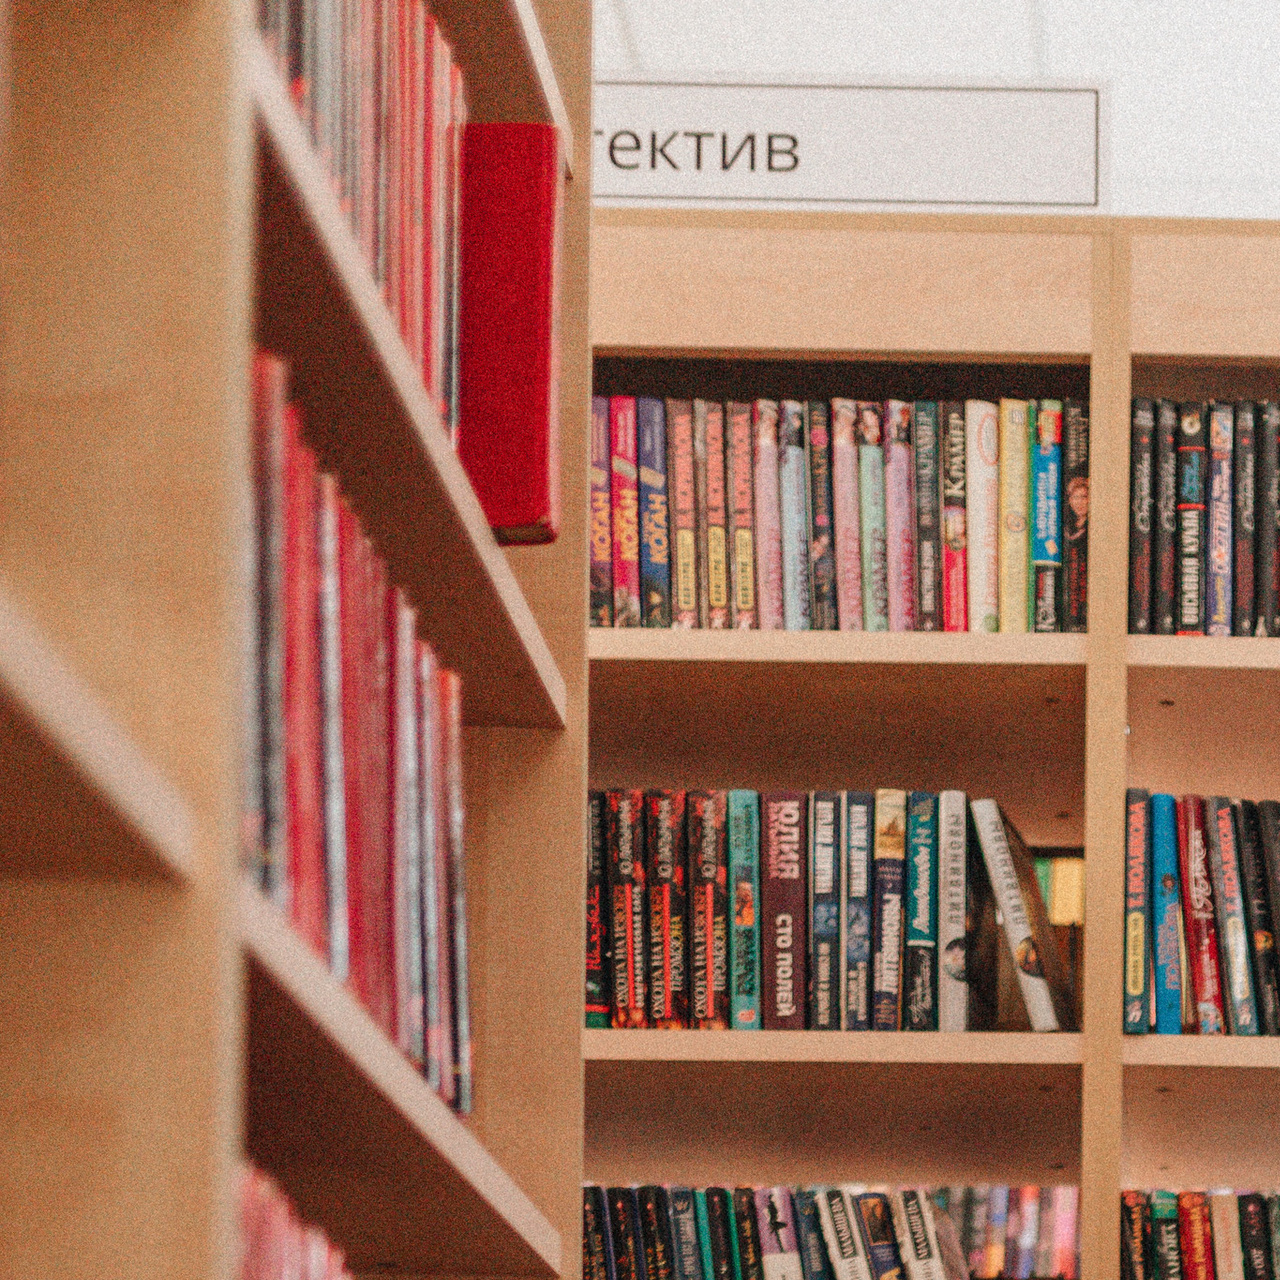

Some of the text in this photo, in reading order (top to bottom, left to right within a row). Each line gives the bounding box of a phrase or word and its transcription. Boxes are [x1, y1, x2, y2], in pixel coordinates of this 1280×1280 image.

[594, 492, 611, 562] КОГАН
[620, 488, 638, 560] КОГАН
[650, 493, 668, 564] КОГАН
[779, 801, 799, 879] ЮЛИЯ
[776, 914, 795, 1017] СТО ПОЛЕЙ
